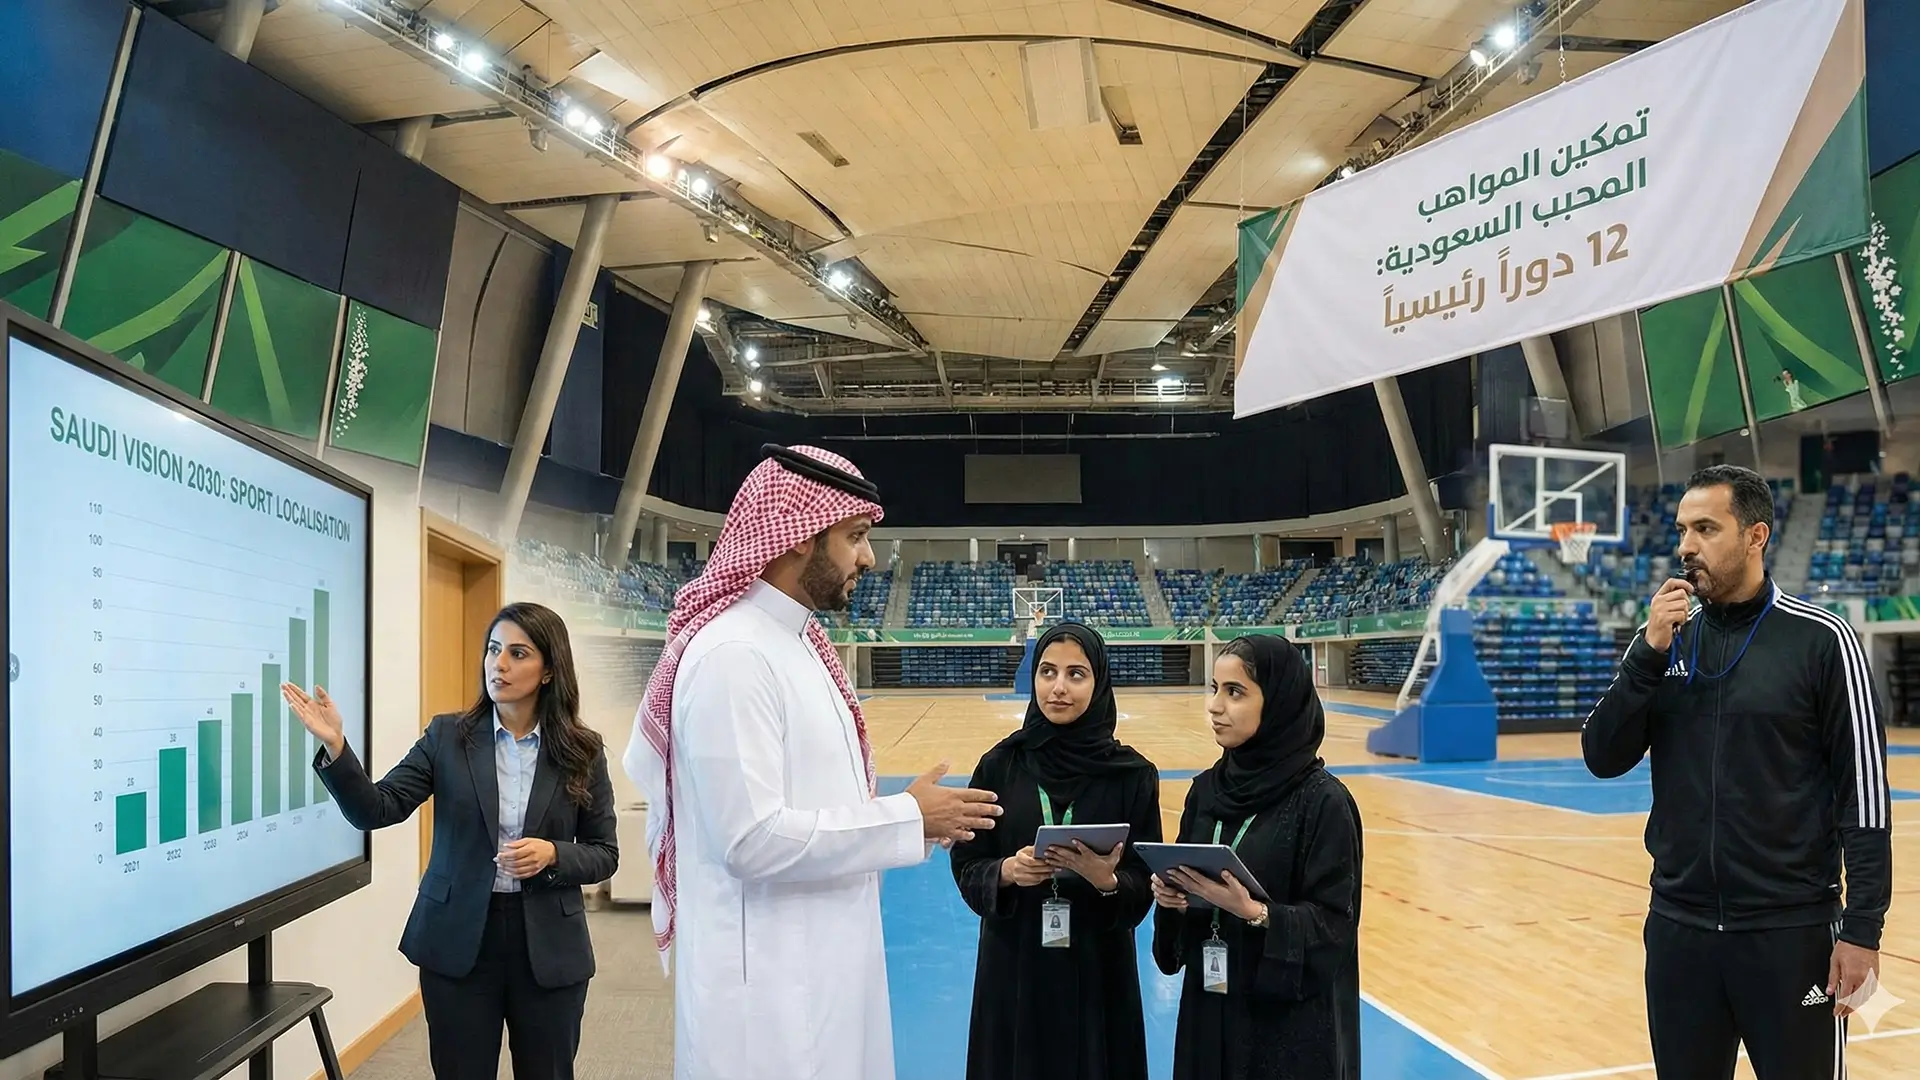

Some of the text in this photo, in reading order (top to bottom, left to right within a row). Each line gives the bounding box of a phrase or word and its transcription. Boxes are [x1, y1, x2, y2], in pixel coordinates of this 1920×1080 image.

[1418, 107, 1650, 223] تمكين المواهب
[1377, 201, 1522, 275] السعودية:
[1587, 223, 1629, 267] 12
[50, 406, 350, 543] SAUDI VISION 2030: SPORT LOCALISATION
[89, 502, 103, 515] 110
[89, 534, 103, 546] 100
[92, 567, 103, 578] 90
[93, 630, 103, 642] 75
[93, 695, 103, 706] 50
[93, 727, 103, 737] 40
[93, 759, 103, 770] 30
[94, 791, 103, 802] 20
[94, 822, 103, 832] 10
[97, 854, 103, 864] 0
[123, 861, 140, 874] 2021
